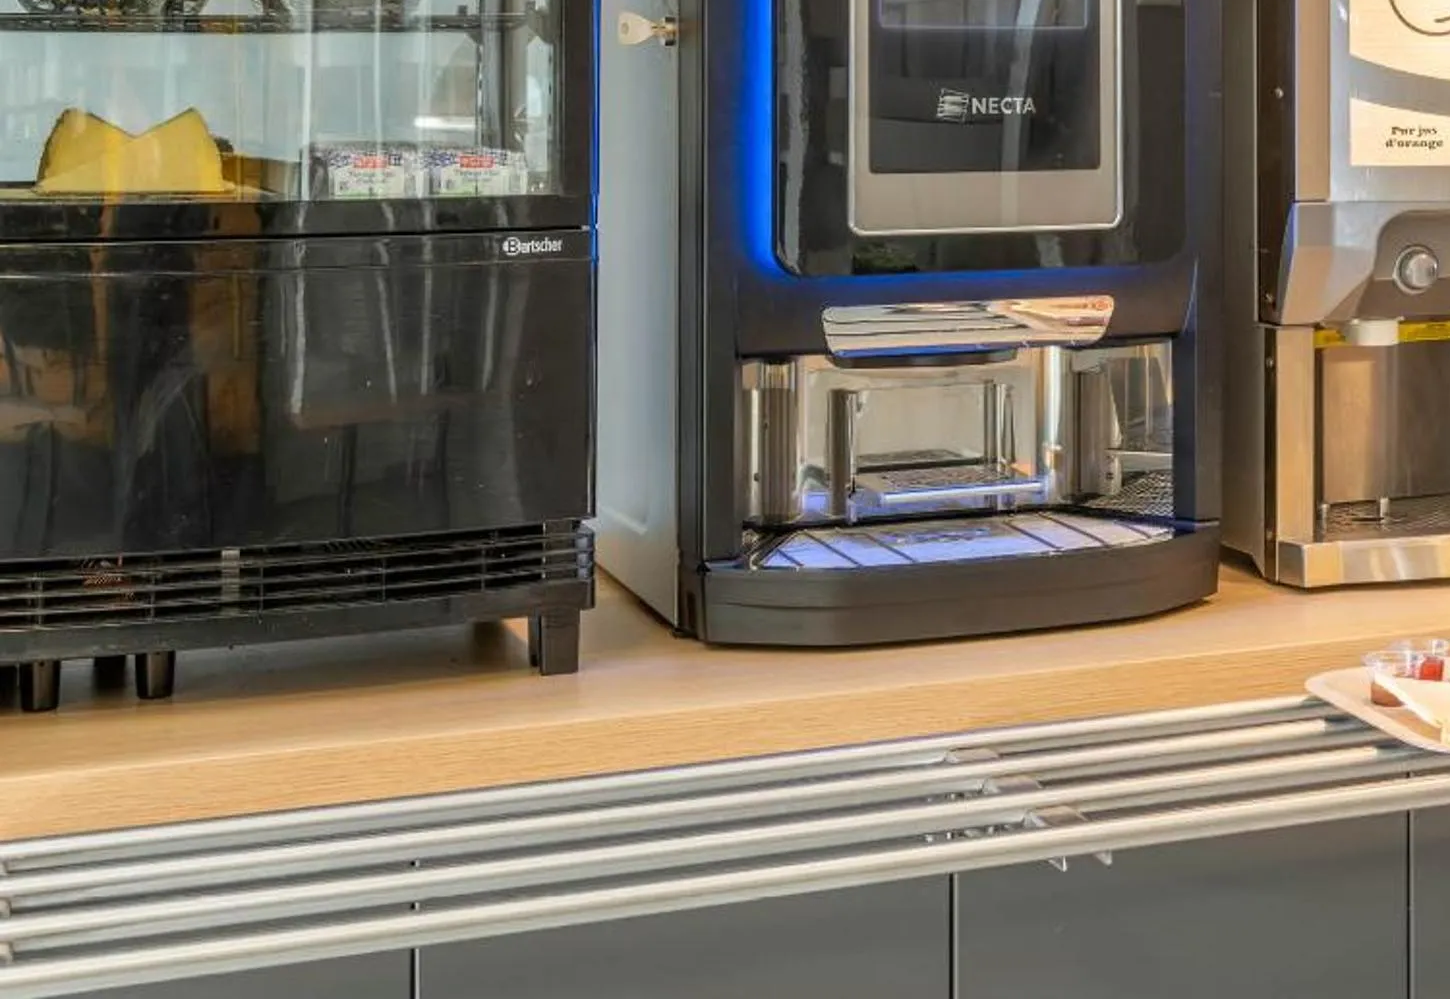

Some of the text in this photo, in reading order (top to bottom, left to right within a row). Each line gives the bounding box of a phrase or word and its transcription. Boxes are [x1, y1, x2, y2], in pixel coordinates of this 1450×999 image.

[971, 97, 1037, 115] NECTA
[1391, 125, 1438, 138] Pur jus
[1385, 138, 1444, 150] d'orange
[502, 237, 563, 256] Bartscher
